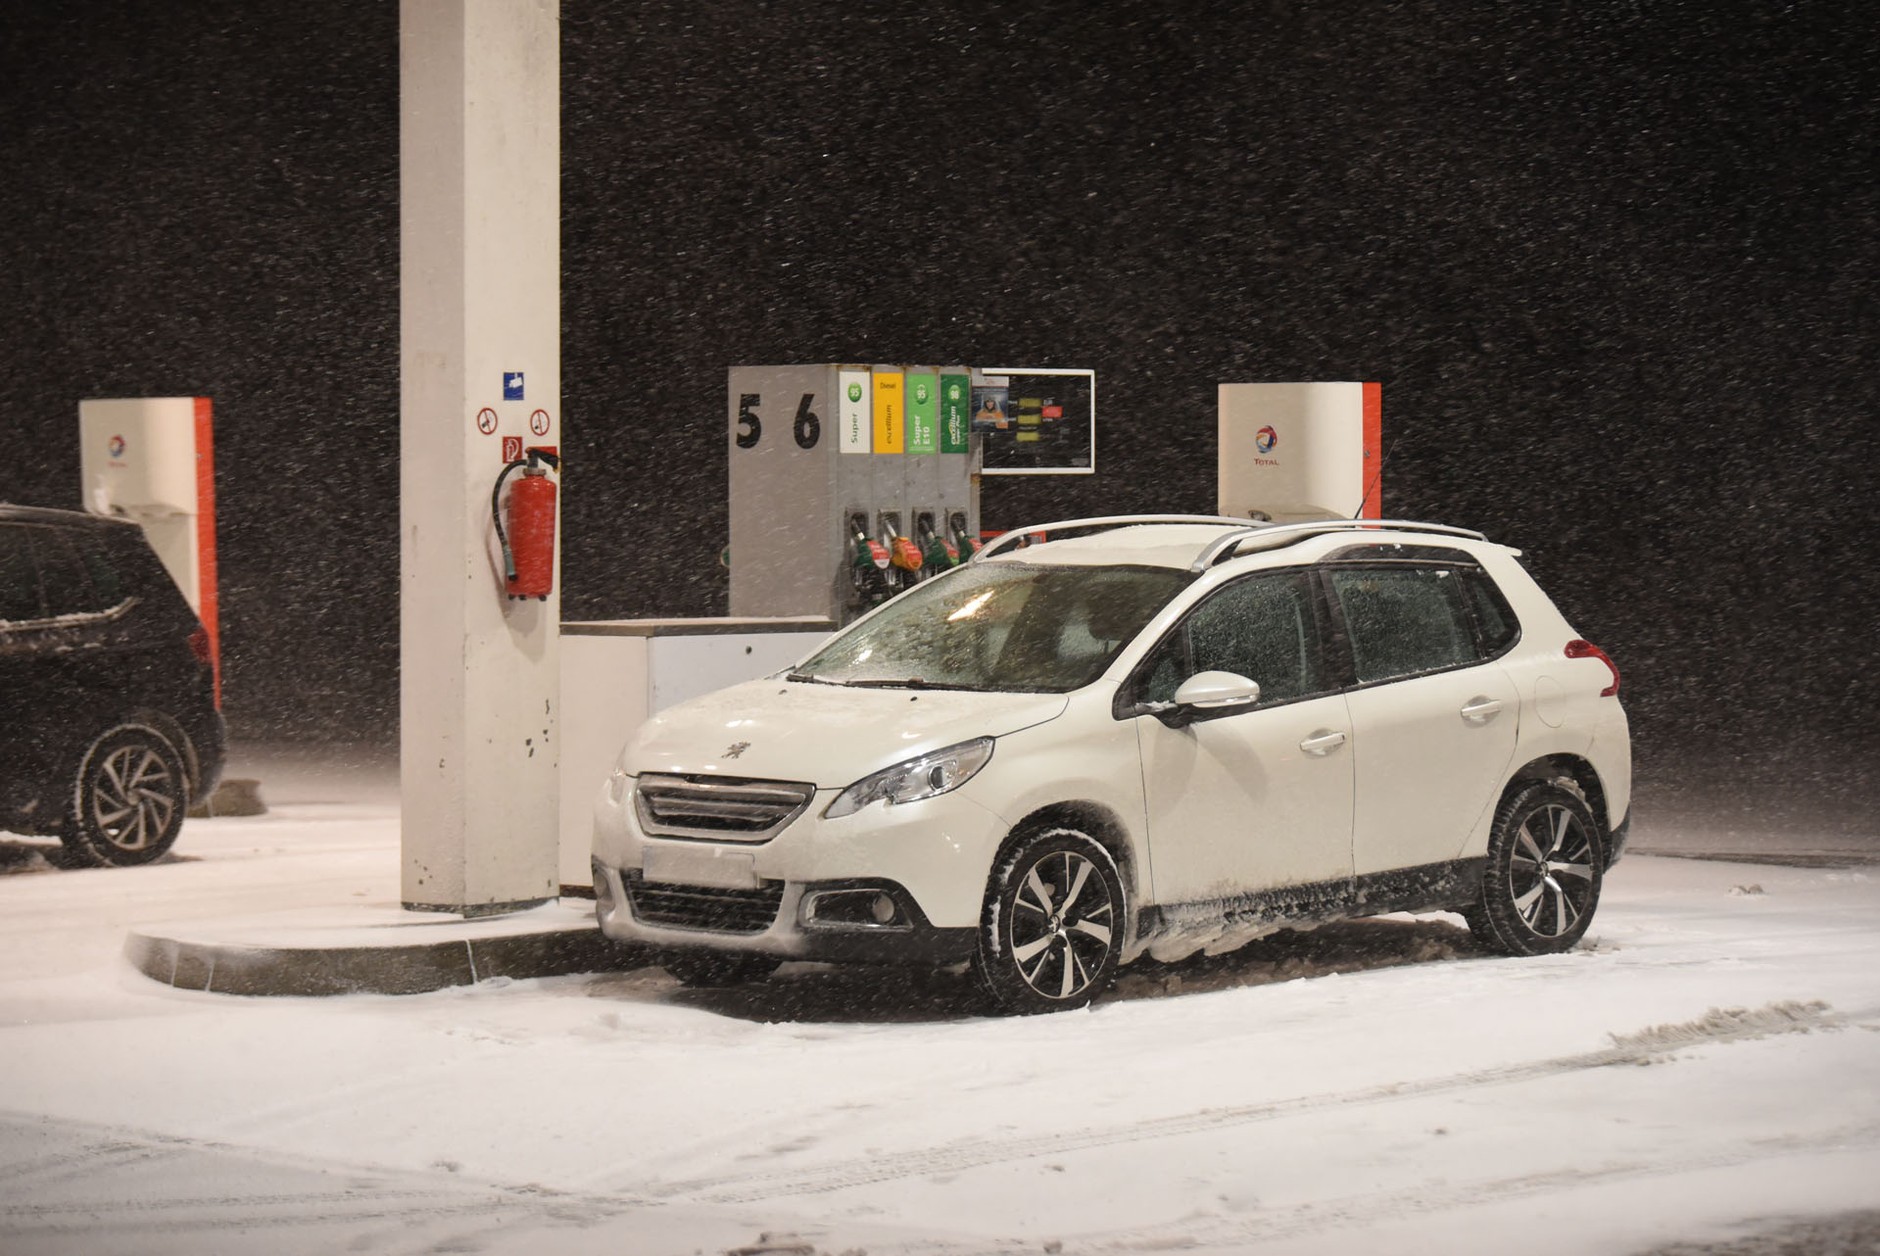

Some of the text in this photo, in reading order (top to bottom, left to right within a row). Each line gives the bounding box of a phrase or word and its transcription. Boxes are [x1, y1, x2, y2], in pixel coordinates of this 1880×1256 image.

[736, 393, 762, 449] 5
[793, 393, 820, 449] 6
[851, 414, 859, 443] Super
[913, 415, 922, 445] Super
[923, 426, 931, 445] E10
[1254, 457, 1279, 465] TOTAL
